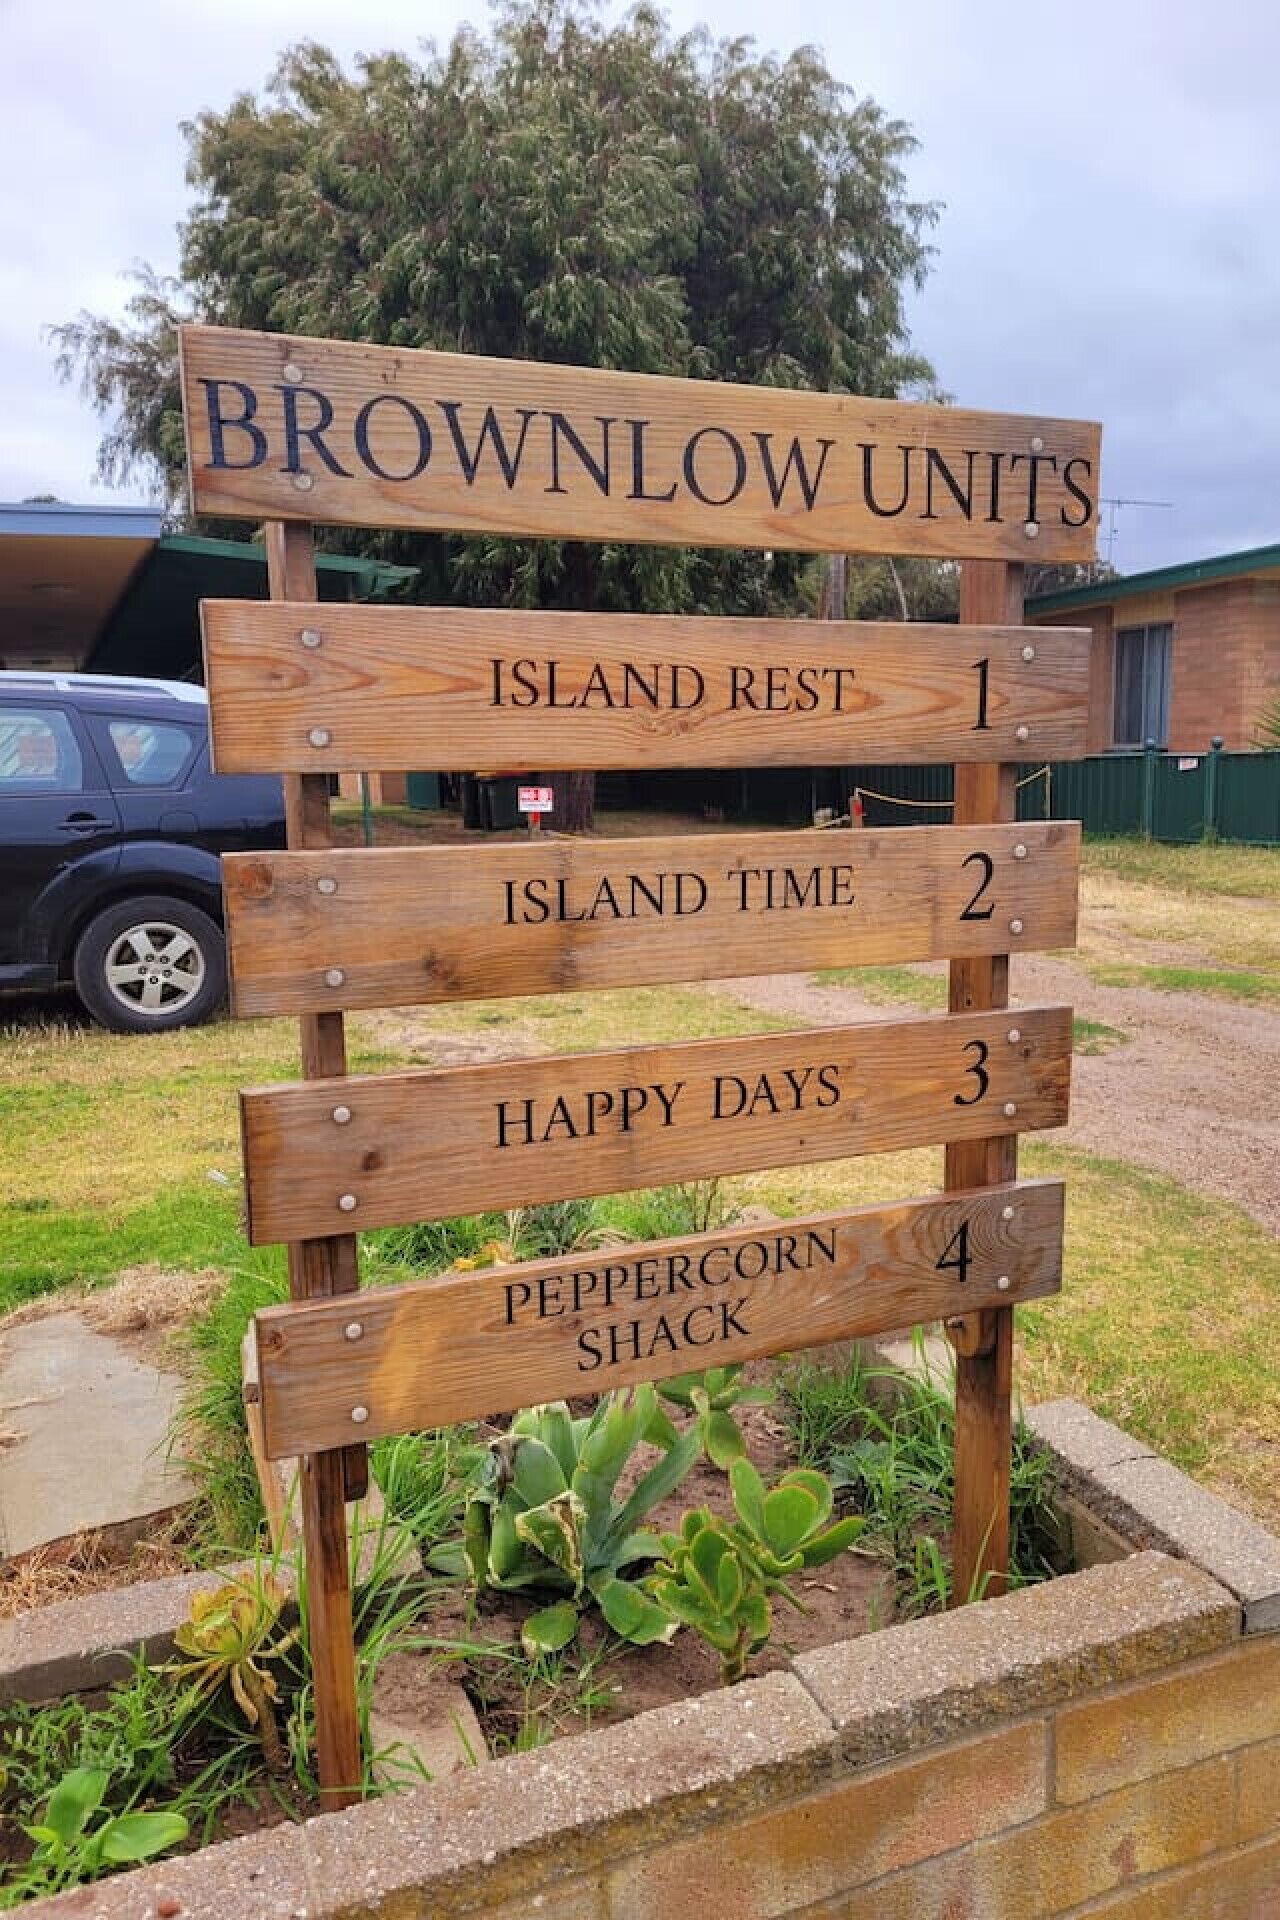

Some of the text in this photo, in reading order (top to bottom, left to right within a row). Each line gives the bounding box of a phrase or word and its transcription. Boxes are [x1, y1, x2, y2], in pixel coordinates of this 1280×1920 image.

[198, 377, 1093, 527] BROWNLOW UNITS
[489, 657, 992, 731] ISLAND REST 1
[502, 851, 996, 925] ISLAND TIME 2
[493, 1039, 989, 1149] HAPPY DAYS 3
[503, 1220, 973, 1325] PEPPERCORN 4
[576, 1296, 751, 1372] SHACK
